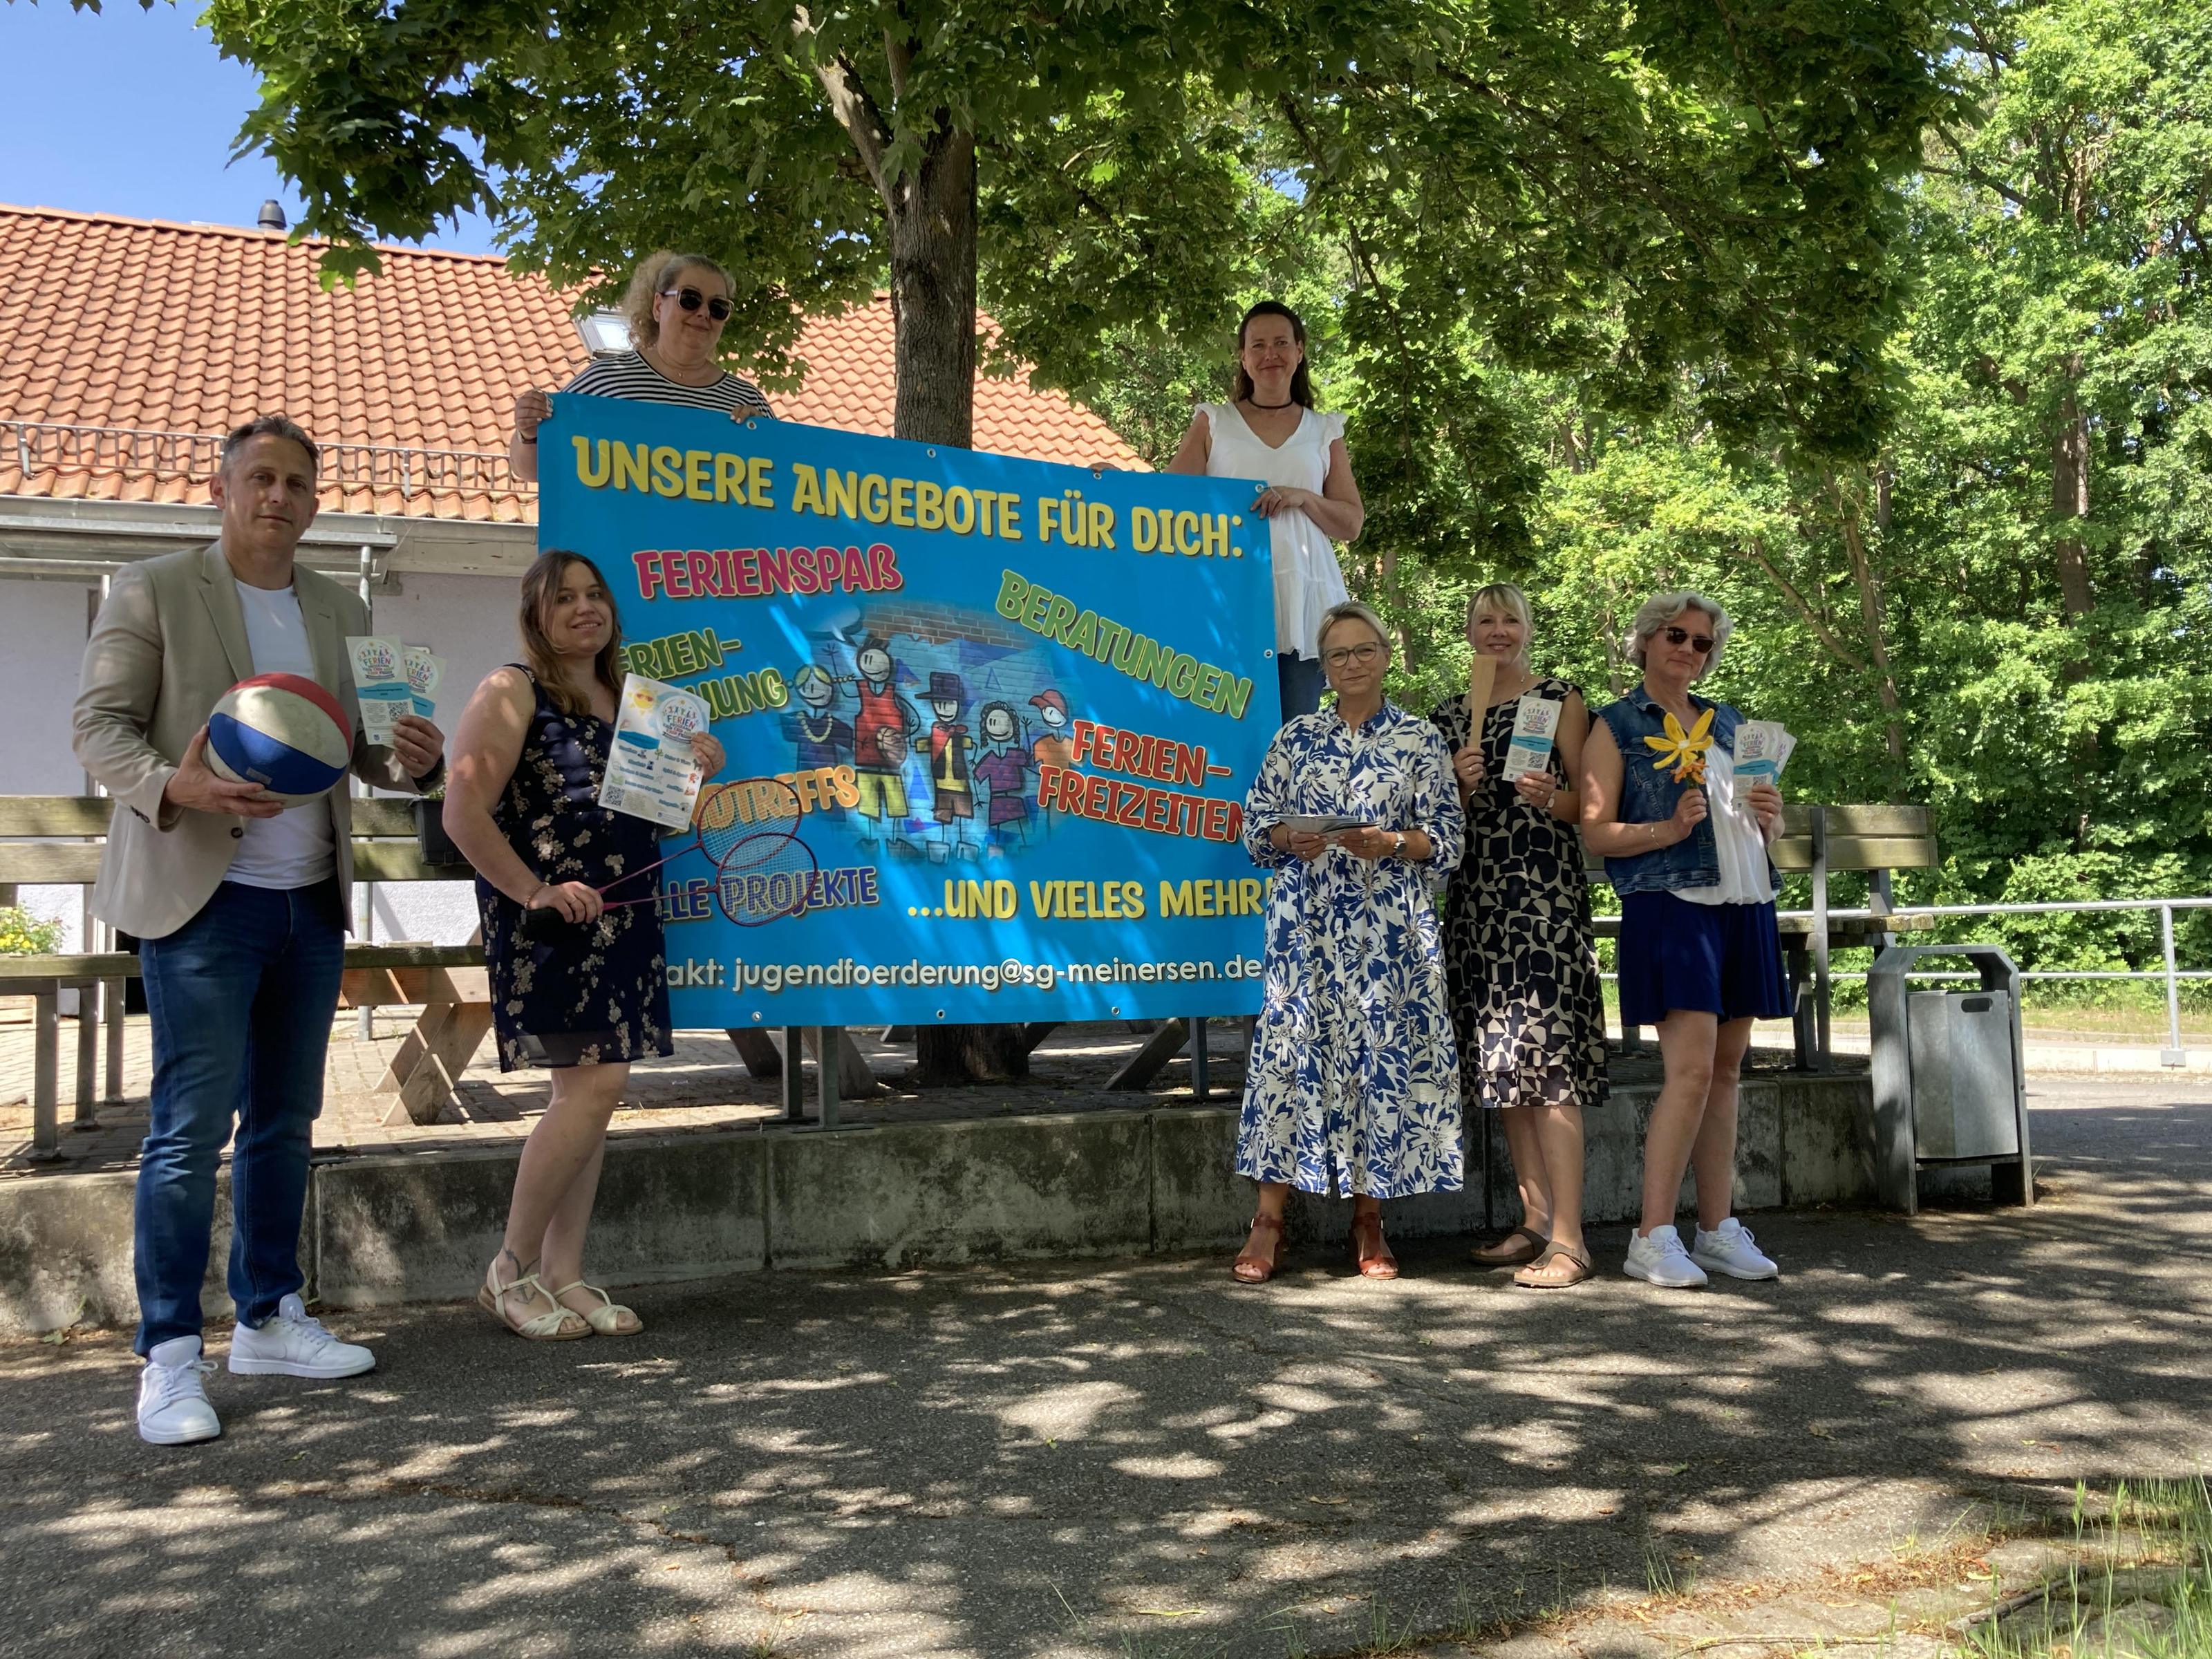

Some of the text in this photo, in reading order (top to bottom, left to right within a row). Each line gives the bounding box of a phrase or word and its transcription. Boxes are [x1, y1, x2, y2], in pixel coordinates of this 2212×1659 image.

[571, 435, 1243, 557] UNSERE ANGEBOTE FÜR DICH:
[632, 543, 903, 599] FERIENSPAß
[995, 569, 1252, 720] BERATUNGEN
[406, 666, 429, 682] ERIEN
[666, 713, 696, 730] FERIEN
[1073, 719, 1232, 787] FERIEN-
[1038, 765, 1245, 843] FREIZEITEN
[720, 865, 879, 918] PROJEKTE
[908, 879, 1017, 919] ...UND
[1029, 880, 1145, 919] VIELES
[732, 953, 1263, 993] jugendfoerderung@sg-meinersen.de
